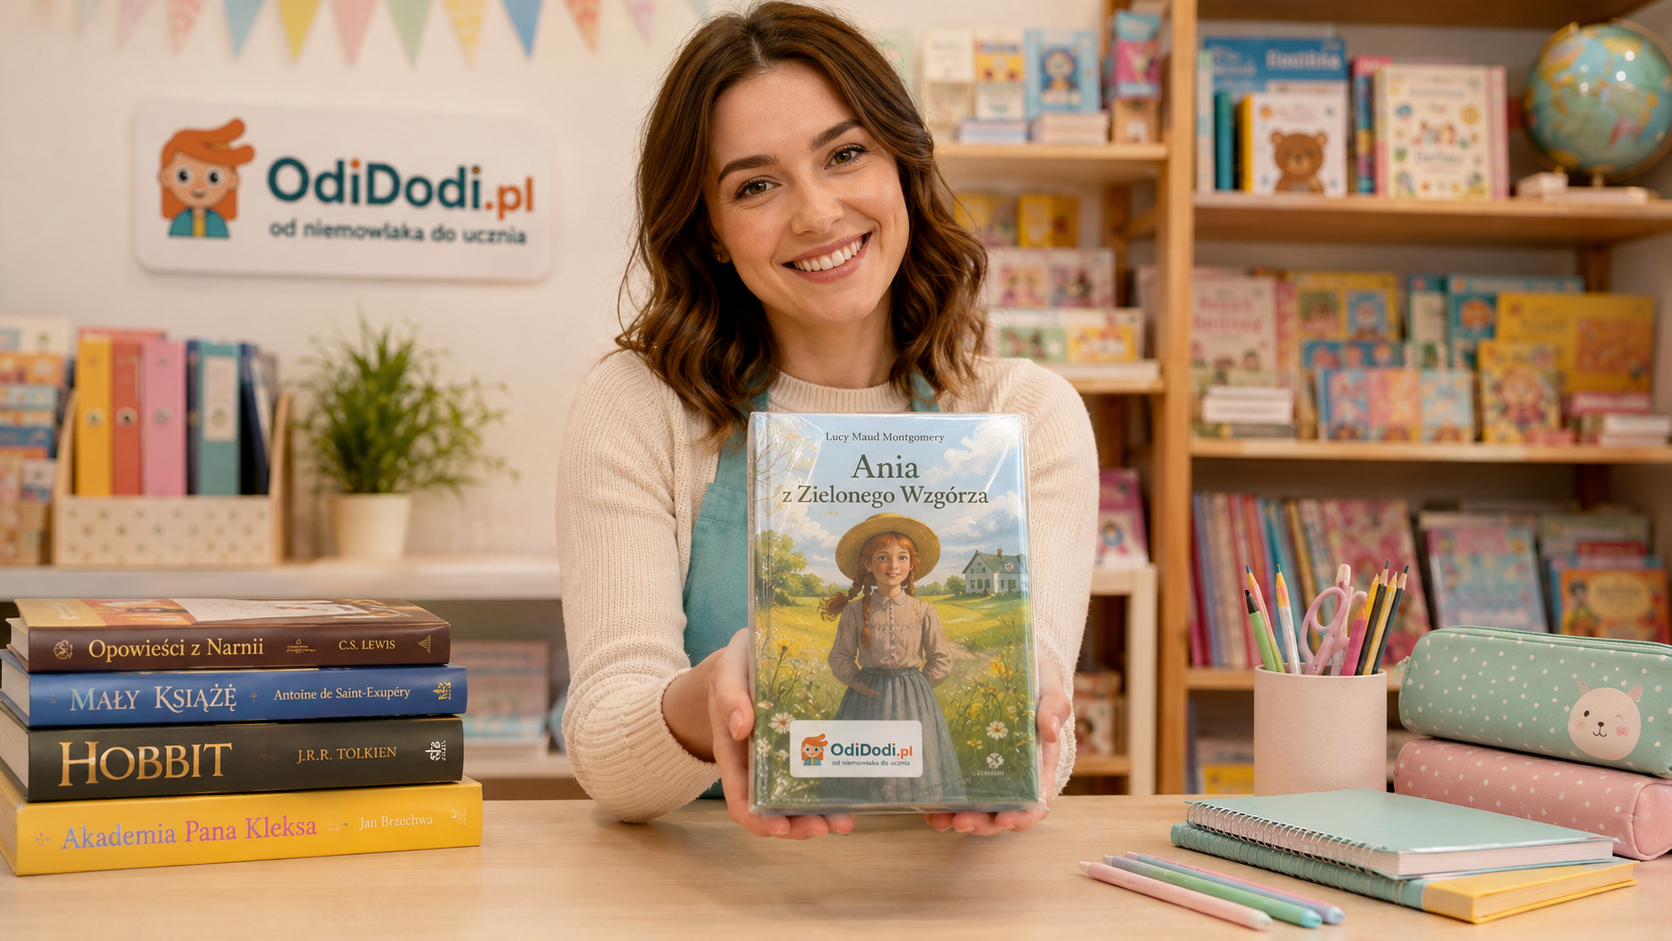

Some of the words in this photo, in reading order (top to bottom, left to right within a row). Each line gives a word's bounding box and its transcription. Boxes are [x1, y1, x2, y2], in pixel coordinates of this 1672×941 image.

[267, 157, 534, 220] OdiDodi.pl
[269, 218, 296, 237] od
[303, 221, 425, 242] niemowlaka
[431, 223, 456, 243] do
[463, 226, 527, 245] ucznia
[825, 432, 849, 443] Lucy
[852, 432, 880, 442] Maud
[882, 432, 945, 444] Montgomery
[851, 454, 920, 479] Ania
[782, 490, 793, 503] z
[798, 485, 895, 509] Zielonego
[900, 485, 989, 509] Wzgórza
[88, 638, 185, 663] Opowieści
[190, 645, 201, 656] z
[206, 638, 264, 656] Narnii
[338, 640, 358, 651] C.S.
[361, 640, 396, 650] LEWIS
[69, 688, 141, 712] MAŁY
[274, 689, 317, 701] Antoine
[319, 687, 333, 700] de
[335, 686, 411, 700] Saint-Exupéry
[296, 749, 333, 765] J.R.R.
[336, 746, 398, 760] TOLKIEN
[830, 742, 912, 759] OdiDodi.pl
[58, 741, 233, 787] HOBBIT
[61, 823, 176, 849] Akademia
[184, 820, 237, 842] Pana
[245, 815, 318, 840] Kleksa
[359, 817, 378, 831] Jan
[381, 814, 434, 828] Brzechwa
